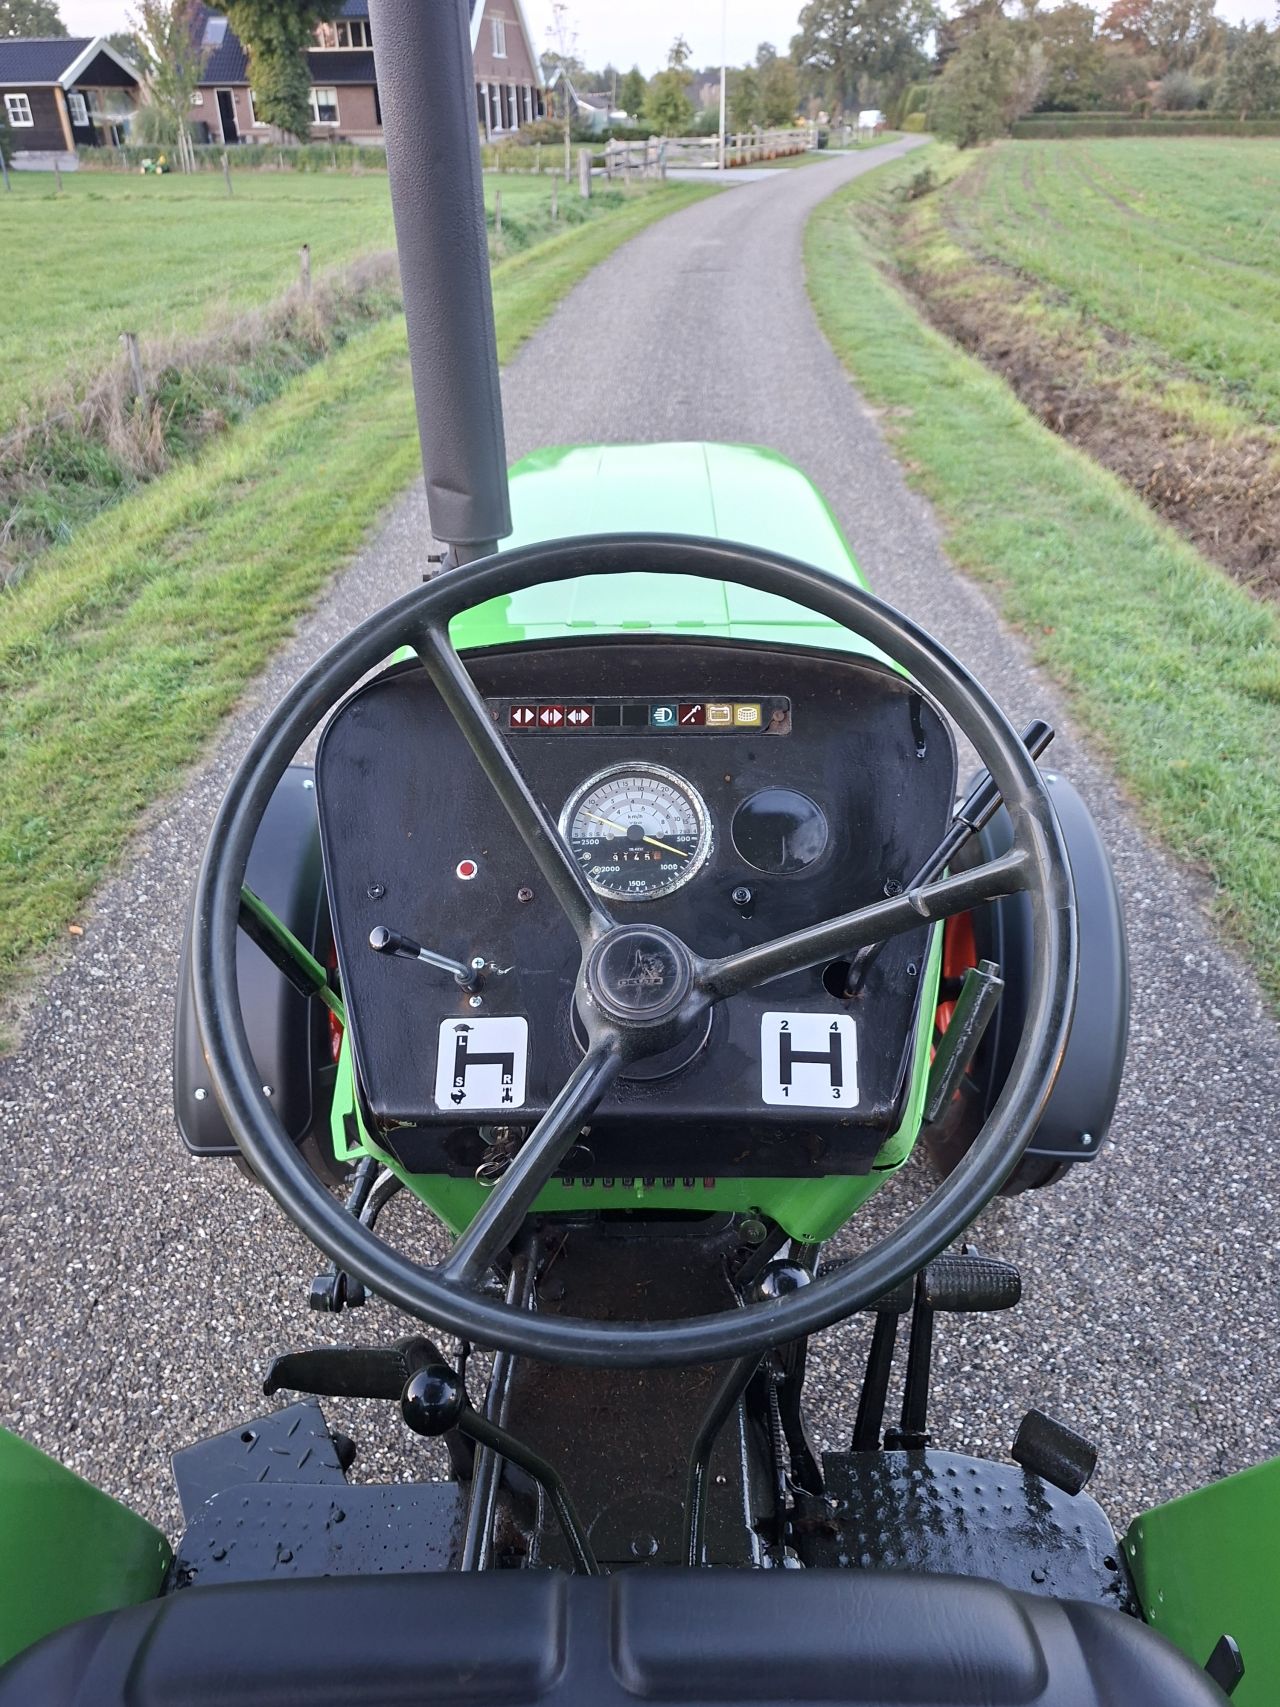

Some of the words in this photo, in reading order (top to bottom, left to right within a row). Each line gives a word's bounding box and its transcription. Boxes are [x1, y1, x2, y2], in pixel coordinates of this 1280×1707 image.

[780, 1020, 789, 1030] 2
[830, 1021, 838, 1031] 4
[459, 1036, 466, 1046] L
[456, 1076, 463, 1086] S
[503, 1074, 512, 1084] R
[782, 1086, 789, 1097] 1
[832, 1088, 841, 1099] 3
